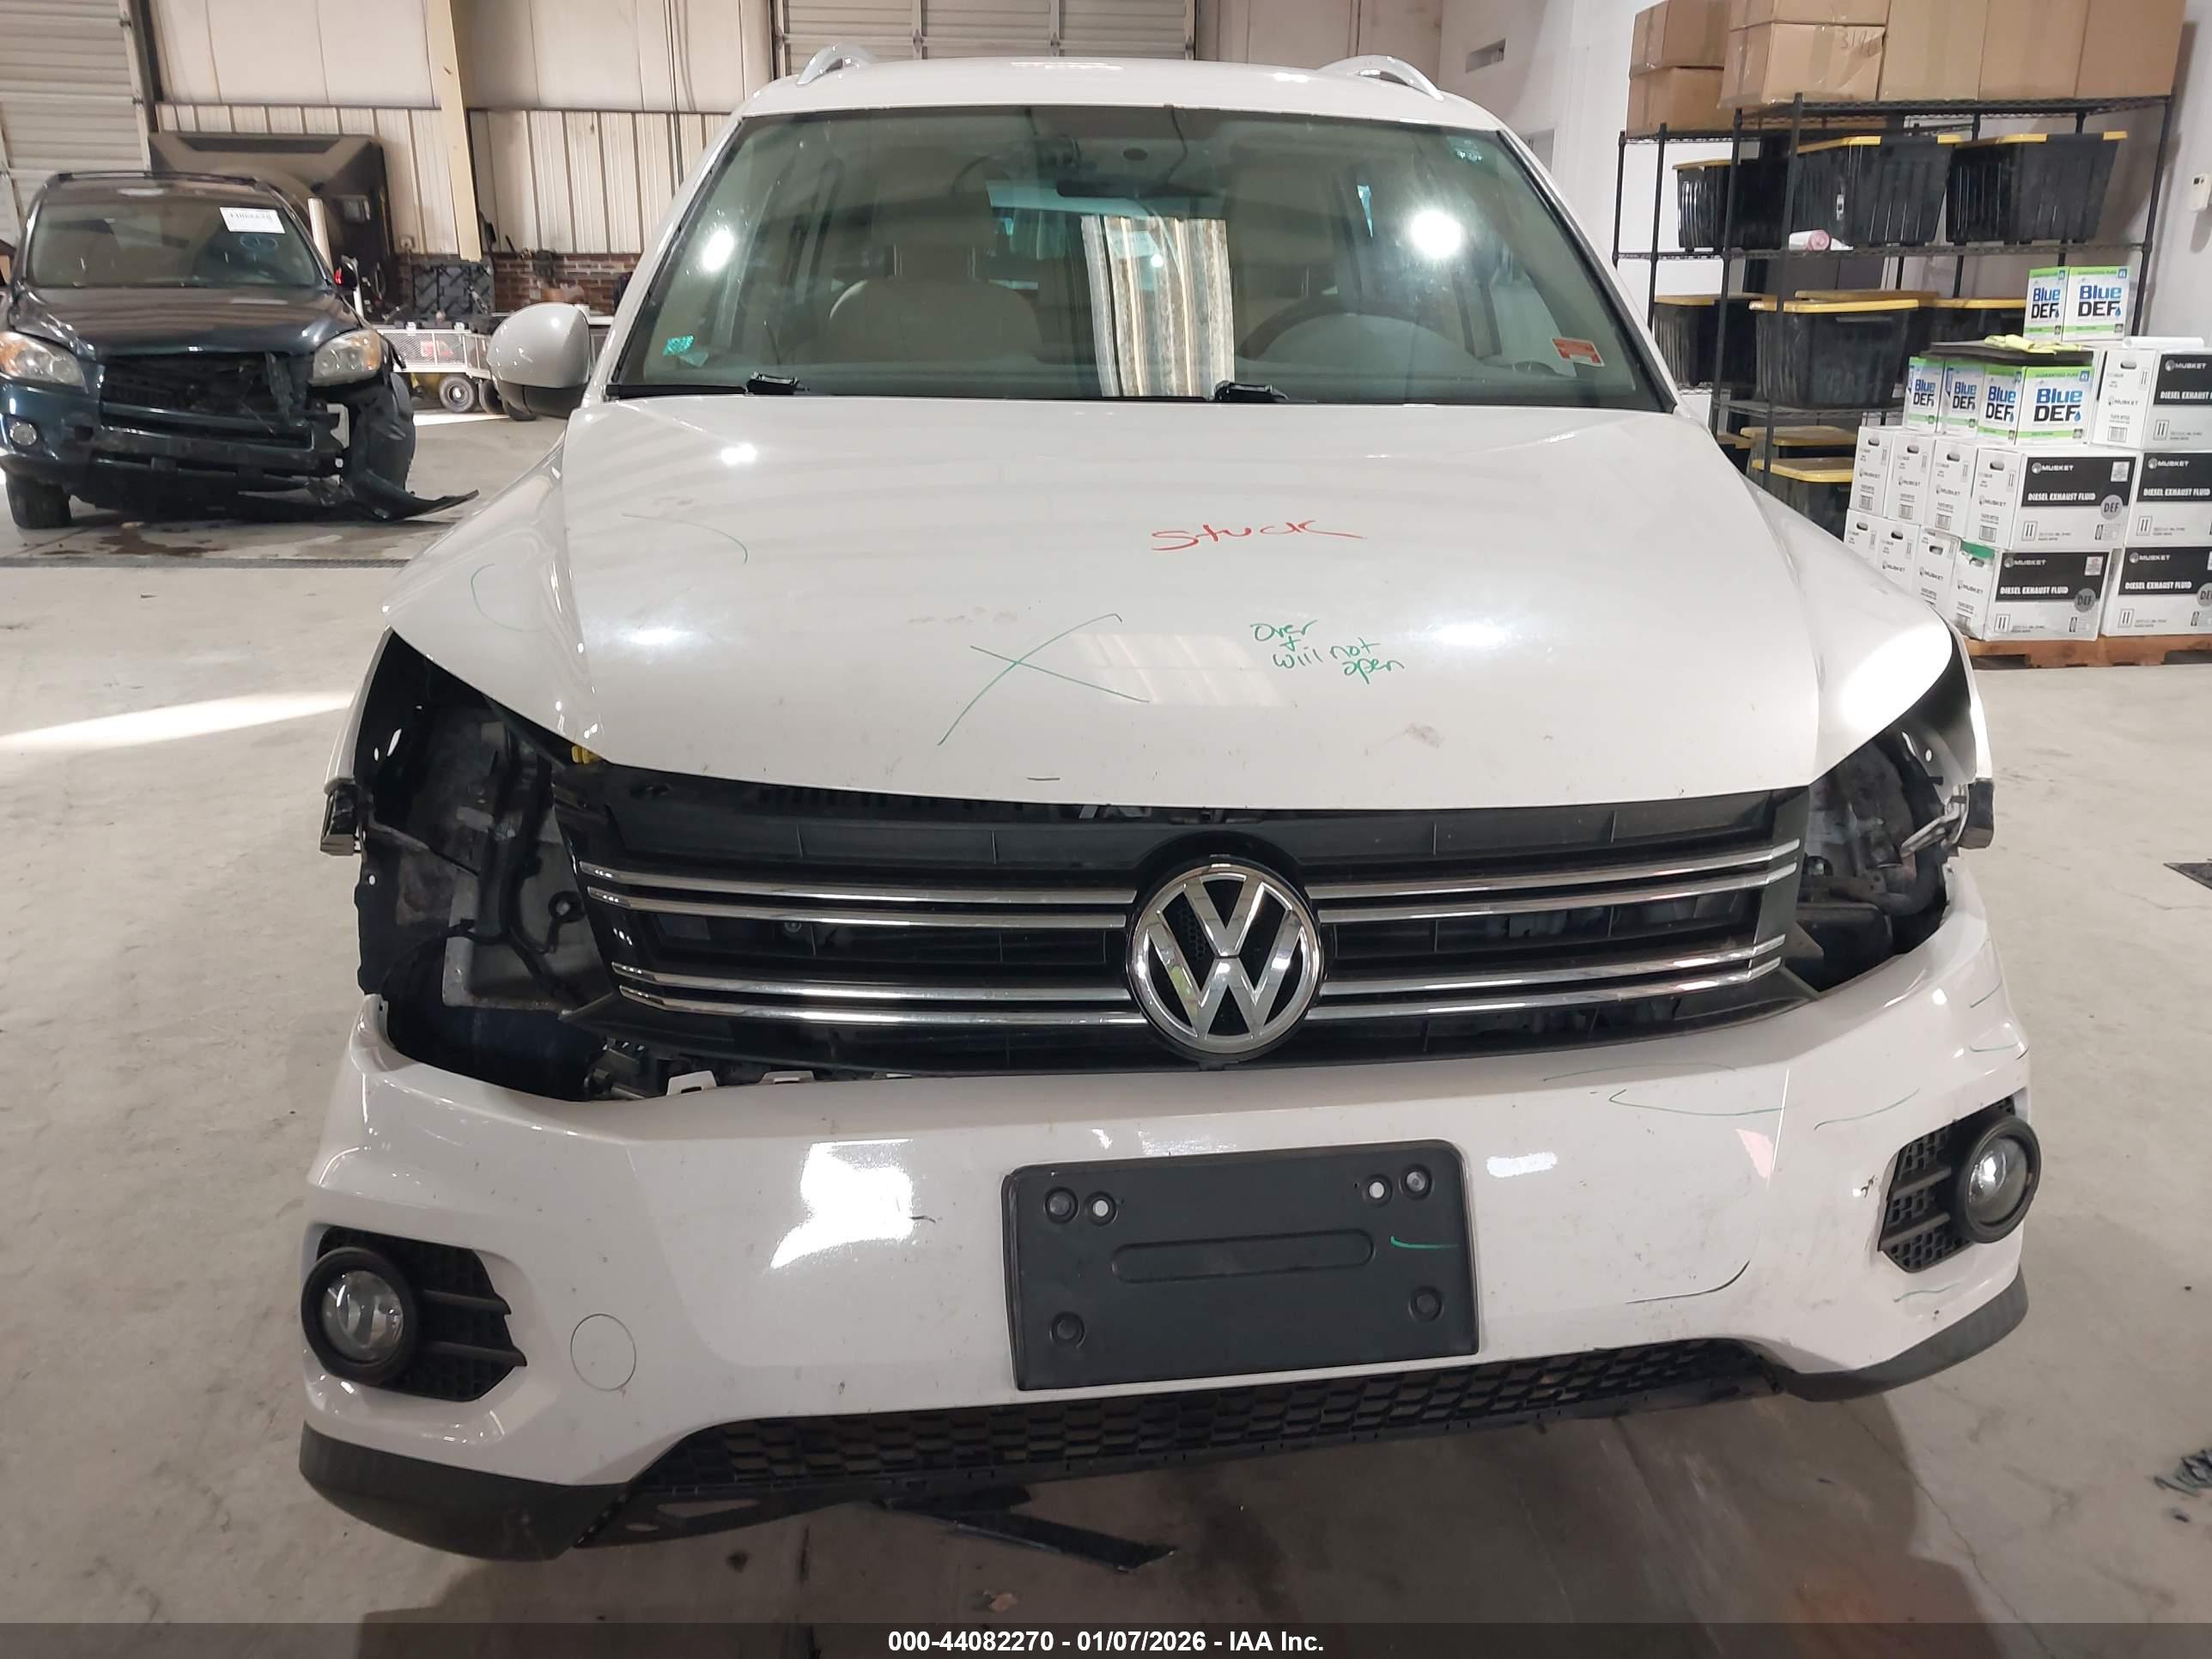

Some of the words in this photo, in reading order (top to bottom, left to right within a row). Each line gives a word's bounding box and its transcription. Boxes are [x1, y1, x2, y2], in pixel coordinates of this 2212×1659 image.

[2033, 287, 2061, 301] Blue
[2080, 285, 2122, 299] Blue
[2031, 302, 2059, 318] DEF
[2078, 301, 2121, 316] DEF
[1915, 380, 1936, 392] Blue
[1954, 381, 1977, 395] Blue
[1913, 392, 1934, 406] DEF
[1988, 386, 2016, 403] Blue
[2036, 388, 2083, 404] Blue
[1953, 395, 1975, 410] DEF
[1985, 403, 2014, 422] DEF
[2033, 405, 2081, 422] DEF
[2027, 493, 2049, 501] DIESEL
[2104, 502, 2119, 513] DEF
[2077, 595, 2092, 606] DEF
[2200, 590, 2212, 600] DE
[1329, 637, 1381, 659] not
[1342, 658, 1405, 684] open
